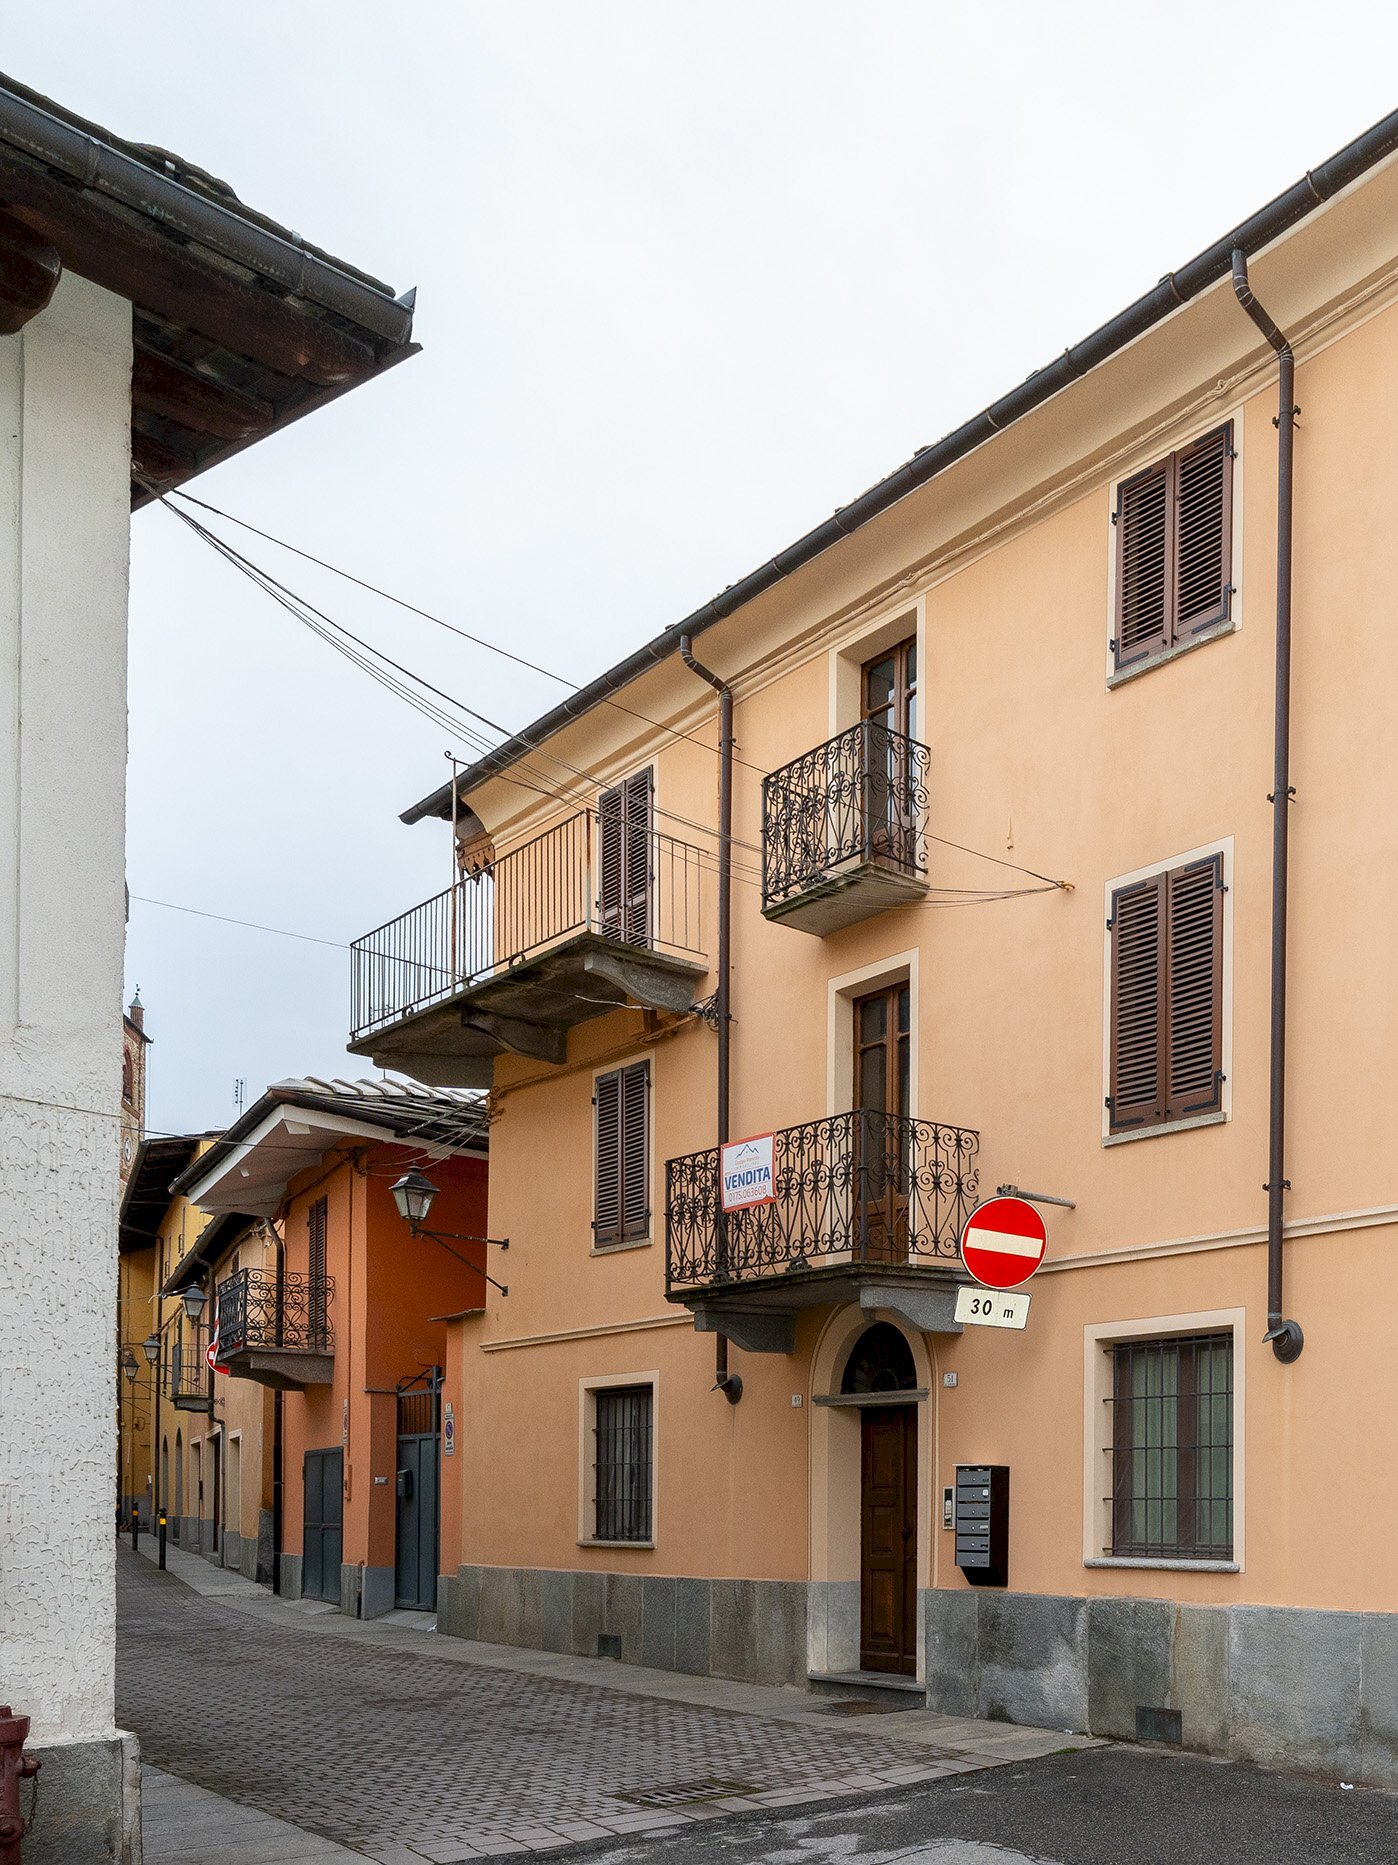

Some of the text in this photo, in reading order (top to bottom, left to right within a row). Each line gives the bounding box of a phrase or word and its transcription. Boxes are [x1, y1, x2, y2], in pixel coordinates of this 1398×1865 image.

[725, 1166, 770, 1190] VENDITA
[970, 1298, 1014, 1319] 30 m
